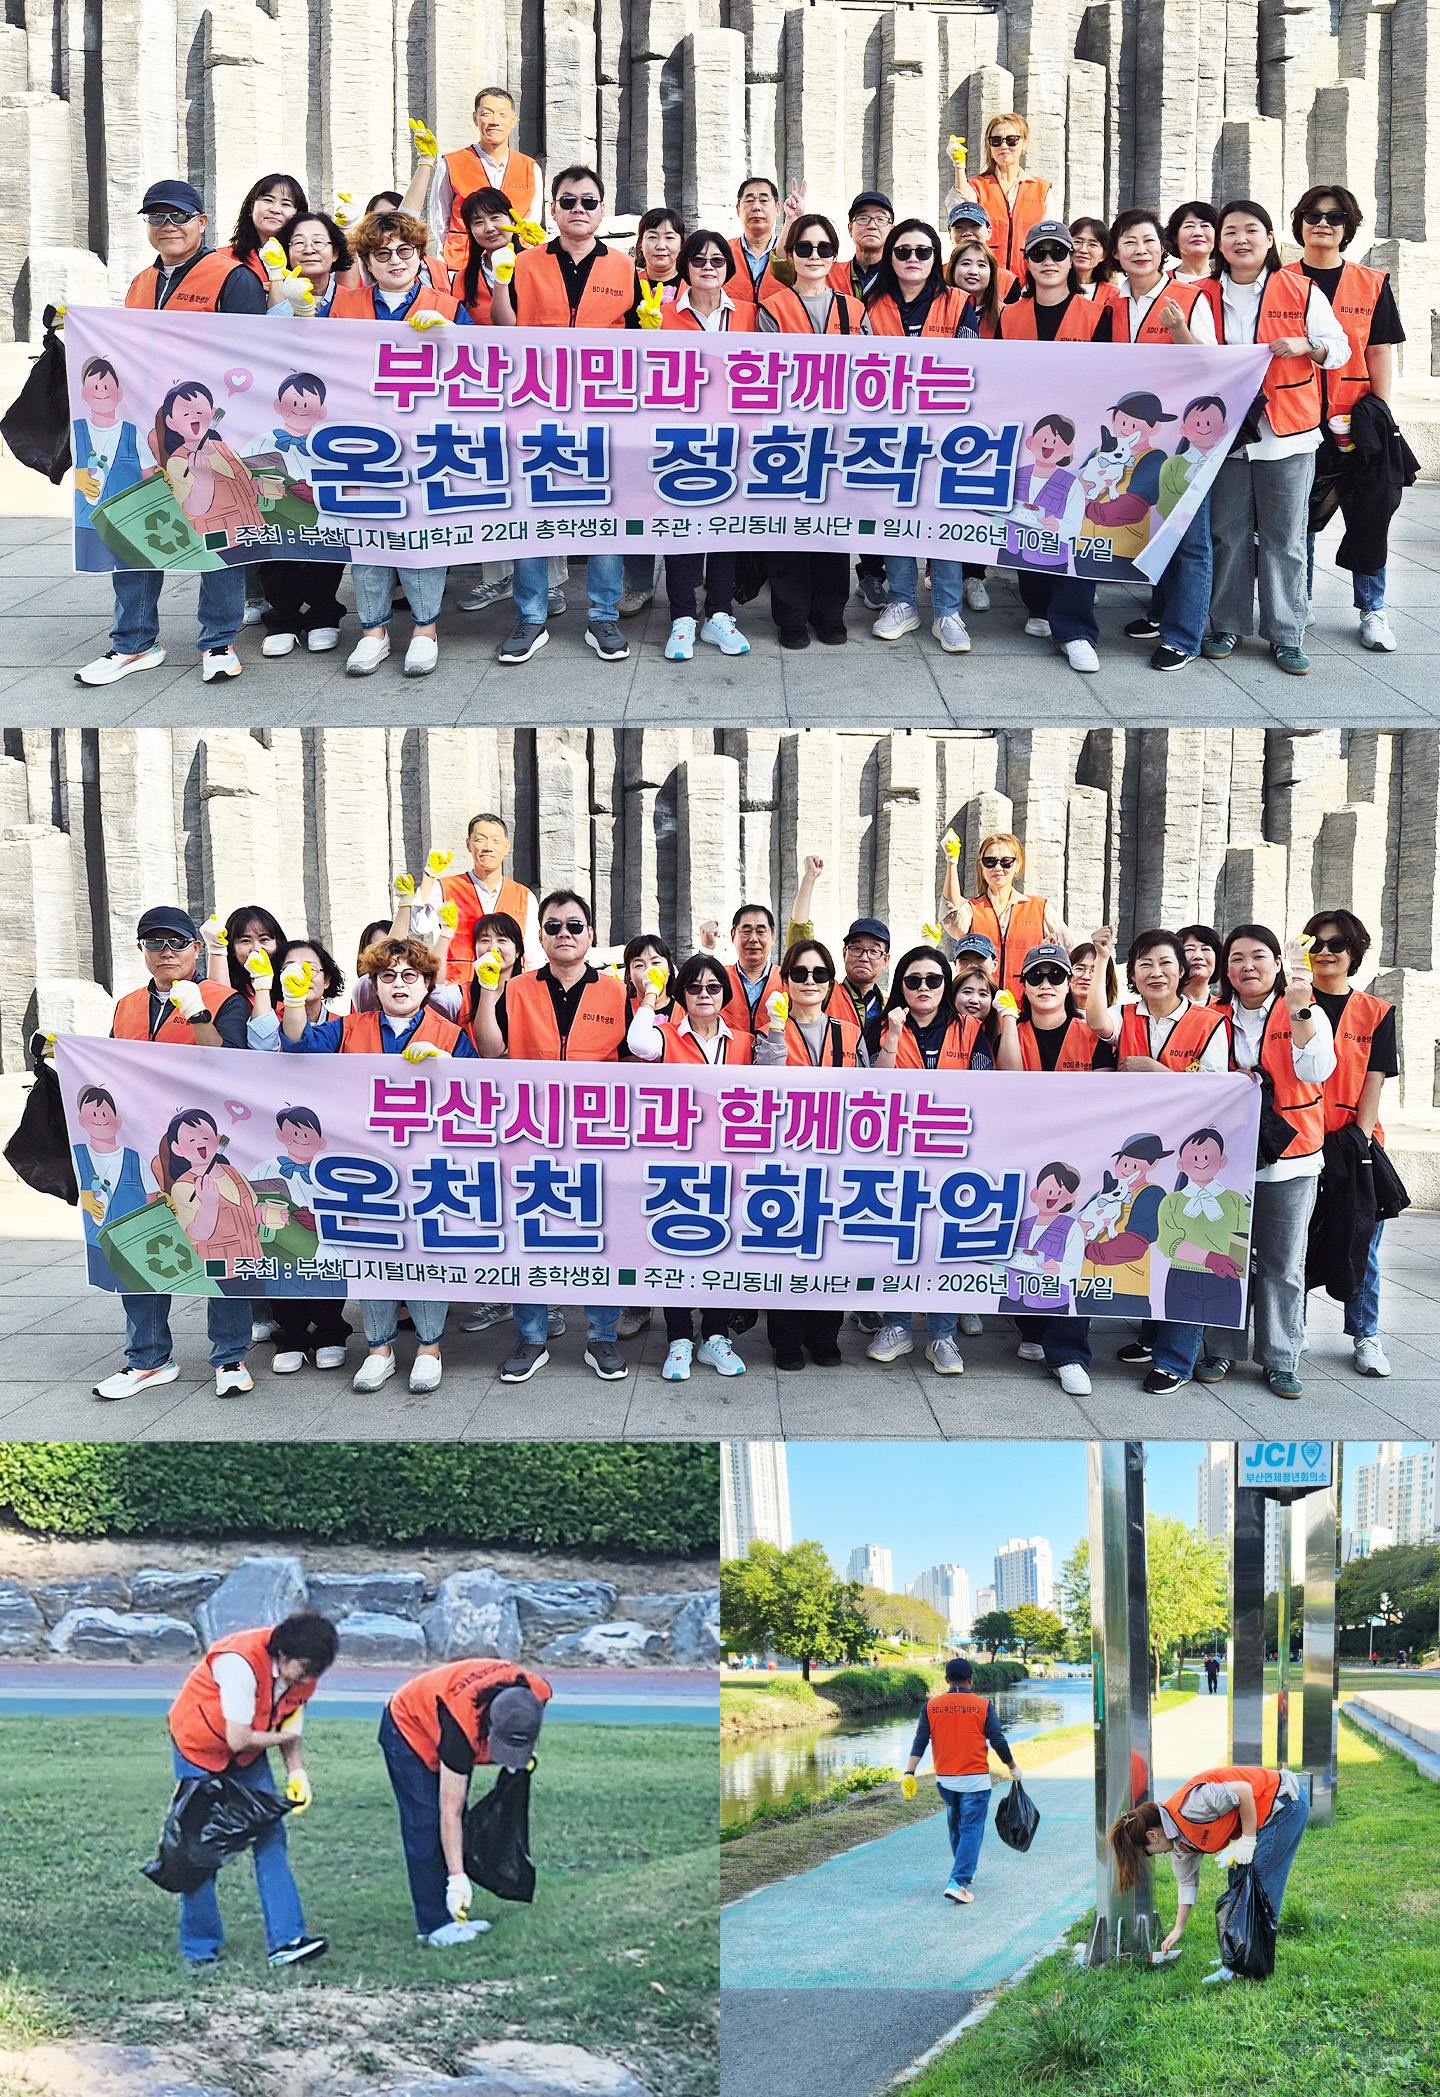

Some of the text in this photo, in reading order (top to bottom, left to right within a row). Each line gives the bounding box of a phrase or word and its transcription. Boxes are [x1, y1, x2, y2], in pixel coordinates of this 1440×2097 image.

[592, 285, 604, 293] BDU
[1340, 306, 1353, 314] BDU
[372, 341, 973, 412] 부산시민과 함께하는
[310, 421, 1021, 516] 온천천 정화작업
[235, 525, 282, 545] 주최
[300, 526, 475, 550] 부산디지털대학교
[481, 521, 528, 542] 22대
[536, 518, 618, 539] 총학생회
[651, 518, 692, 538] 주관
[708, 516, 786, 535] 우리동네
[794, 516, 852, 536] 봉사단
[883, 518, 921, 539] 일시
[938, 524, 1008, 547] 2026년
[1016, 529, 1060, 555] 10월
[1068, 536, 1113, 562] 17일
[368, 1077, 970, 1156] 부산시민과 함께하는
[312, 1155, 1023, 1260] 온천천 정화작업
[234, 1258, 278, 1280] 주최
[297, 1258, 469, 1284] 부산디지털대학교
[474, 1266, 521, 1286] 22대
[528, 1266, 610, 1287] 총학생회
[644, 1268, 685, 1290] 주관
[702, 1270, 782, 1292] 우리동네
[790, 1274, 850, 1294] 봉사단
[882, 1274, 920, 1292] 일시
[938, 1274, 1008, 1296] 2026년
[1016, 1276, 1060, 1297] 10월
[1068, 1278, 1113, 1299] 17일
[1246, 1442, 1297, 1467] JCI
[1246, 1472, 1327, 1483] 부산연제청년회의소
